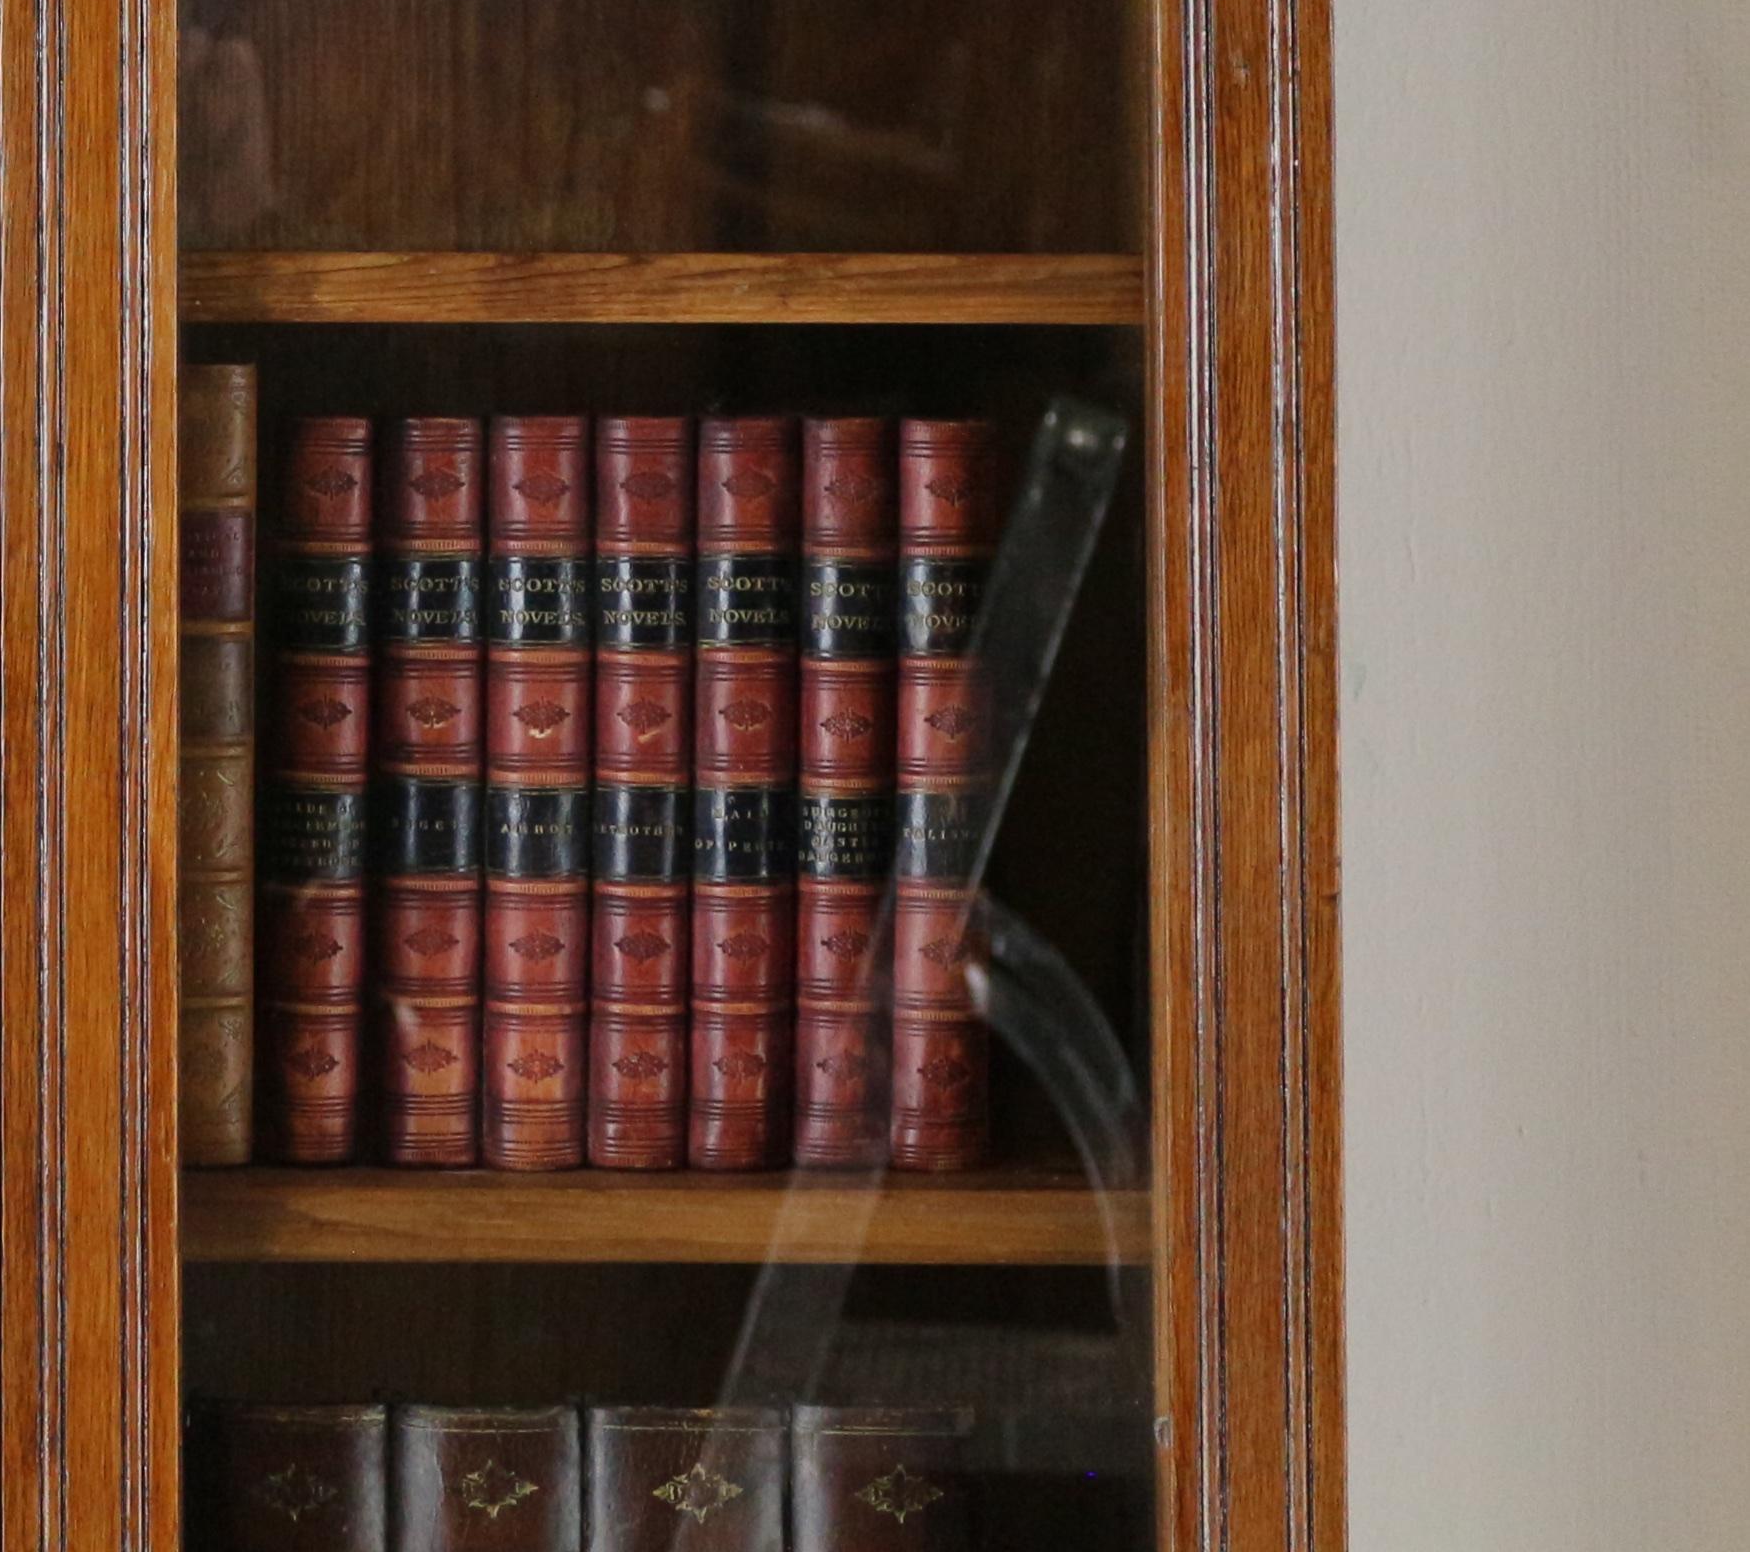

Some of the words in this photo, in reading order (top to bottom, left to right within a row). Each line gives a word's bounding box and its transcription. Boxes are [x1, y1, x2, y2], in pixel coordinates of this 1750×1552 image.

[283, 577, 369, 594] COTT'S
[391, 576, 480, 593] SCOTT'S
[499, 577, 585, 593] SCOTT'S
[601, 577, 688, 593] SCOTT'S
[810, 582, 885, 598] SCOTT
[907, 580, 980, 597] SCOTT
[282, 610, 366, 626] OVELS
[392, 609, 479, 625] NOVELS
[500, 609, 585, 625] NOVELS
[603, 610, 687, 625] NOVELS
[811, 614, 884, 631] NOVEL
[804, 820, 882, 834] DAUGHT
[903, 827, 982, 841] TALISMA
[798, 851, 880, 865] DANGERO
